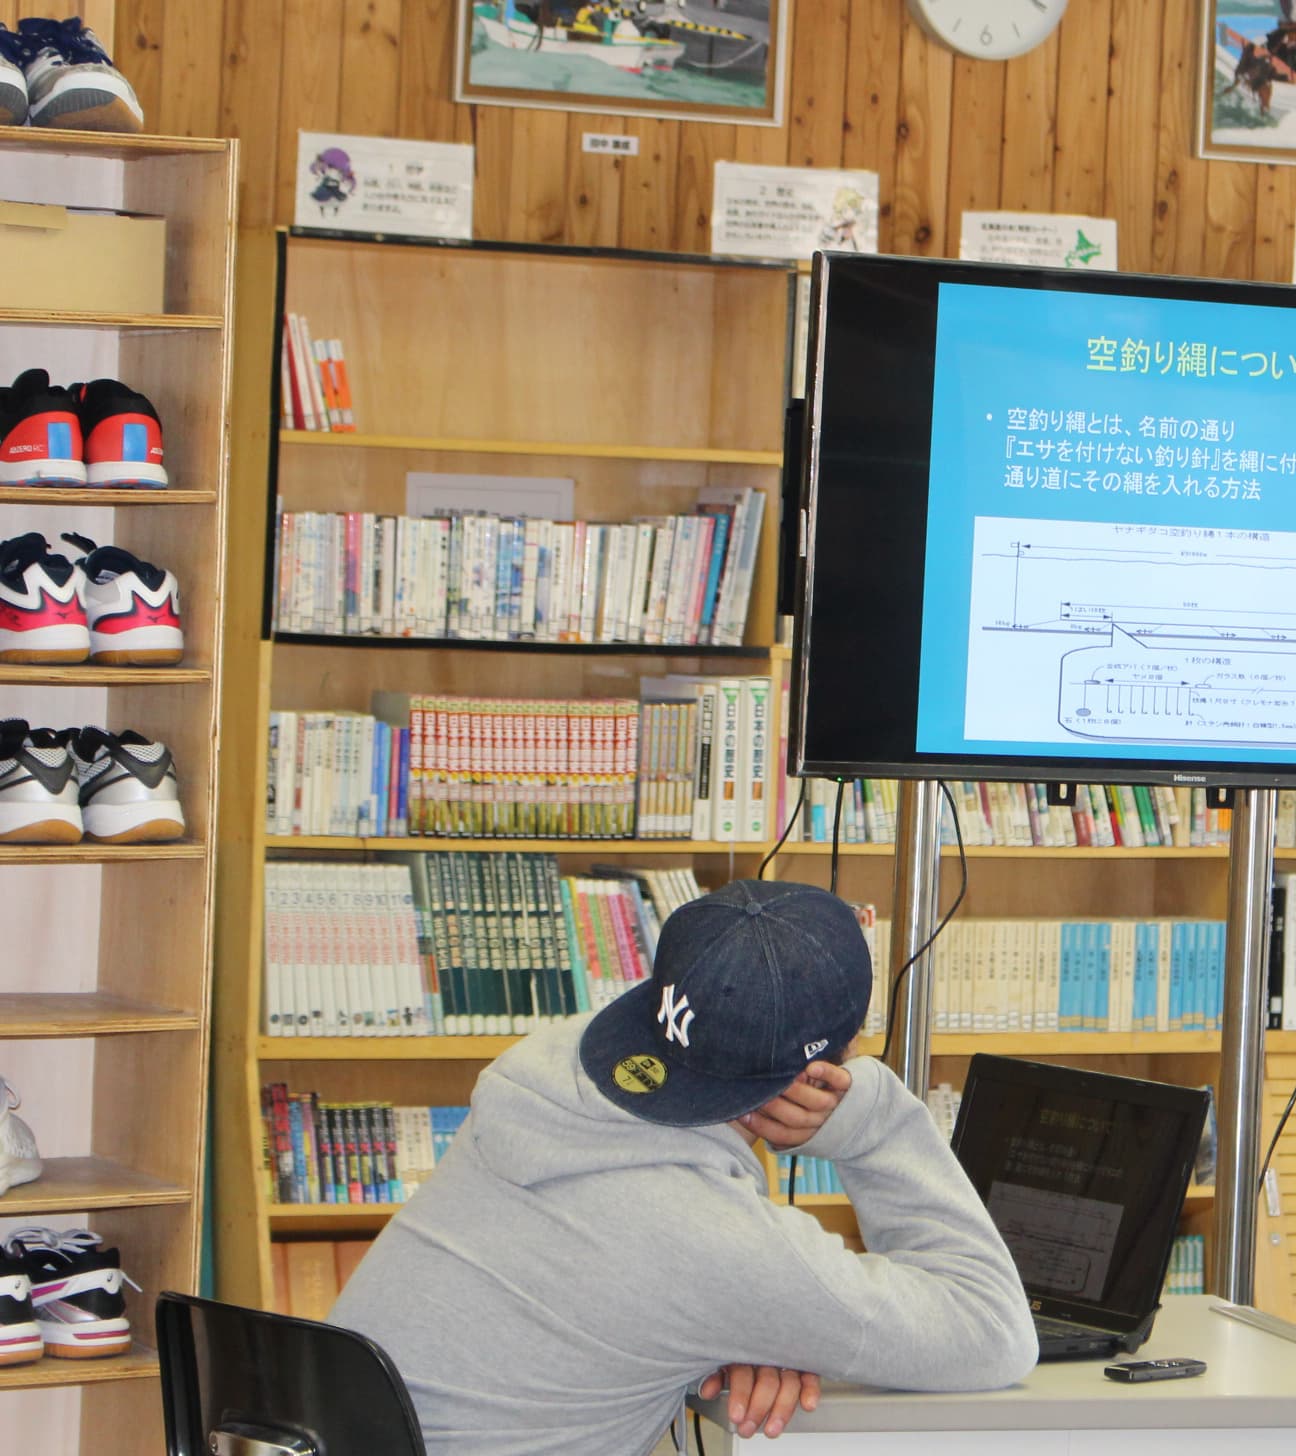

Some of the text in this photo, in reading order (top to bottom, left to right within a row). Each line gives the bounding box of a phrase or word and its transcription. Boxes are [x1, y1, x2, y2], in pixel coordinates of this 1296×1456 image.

[980, 24, 993, 46] 6
[1003, 464, 1261, 501] 通り道にその縄を入れる方法
